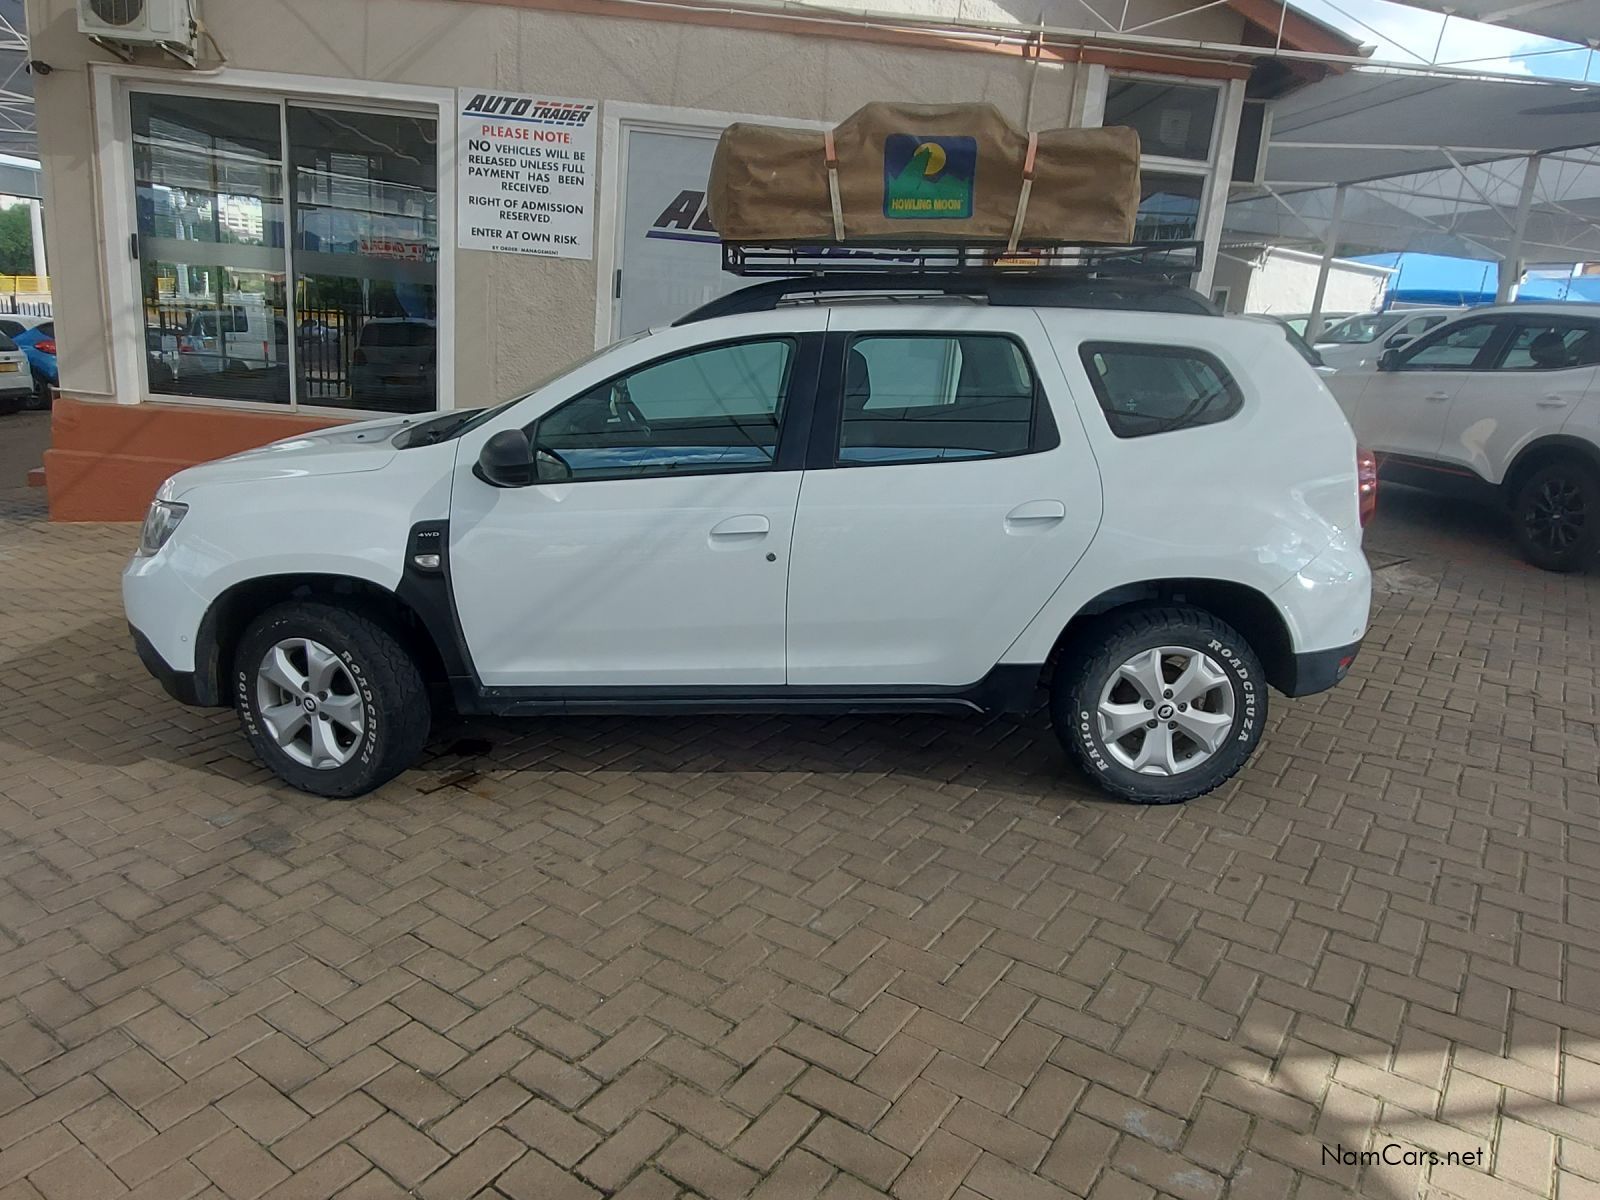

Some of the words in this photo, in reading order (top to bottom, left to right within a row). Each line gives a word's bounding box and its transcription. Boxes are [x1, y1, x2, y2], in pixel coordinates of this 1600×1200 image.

[464, 94, 532, 116] AUTO
[531, 106, 591, 122] TRADER
[482, 125, 529, 140] PLEASE
[468, 139, 491, 152] NO
[495, 144, 541, 157] VEHICLES
[545, 149, 570, 160] WILL
[573, 152, 586, 161] BE
[468, 155, 517, 167] RELEASED
[520, 160, 559, 171] UNLESS
[562, 163, 585, 174] FULL
[468, 167, 520, 180] PAYMENT
[527, 173, 550, 183] HAS
[558, 175, 585, 186] BEEN
[468, 196, 502, 207] RIGHT
[503, 199, 519, 208] OF
[521, 201, 584, 214] ADMISSION
[892, 199, 932, 210] HOWLING
[934, 199, 961, 210] MOON
[471, 227, 503, 239] ENTER
[505, 231, 519, 240] AT
[521, 232, 551, 243] OWN
[521, 247, 559, 255] MANAGEMENT
[1208, 639, 1255, 742] ROADCRUZA
[341, 650, 377, 765] ROADCRUZA
[1080, 710, 1110, 772] RA1100
